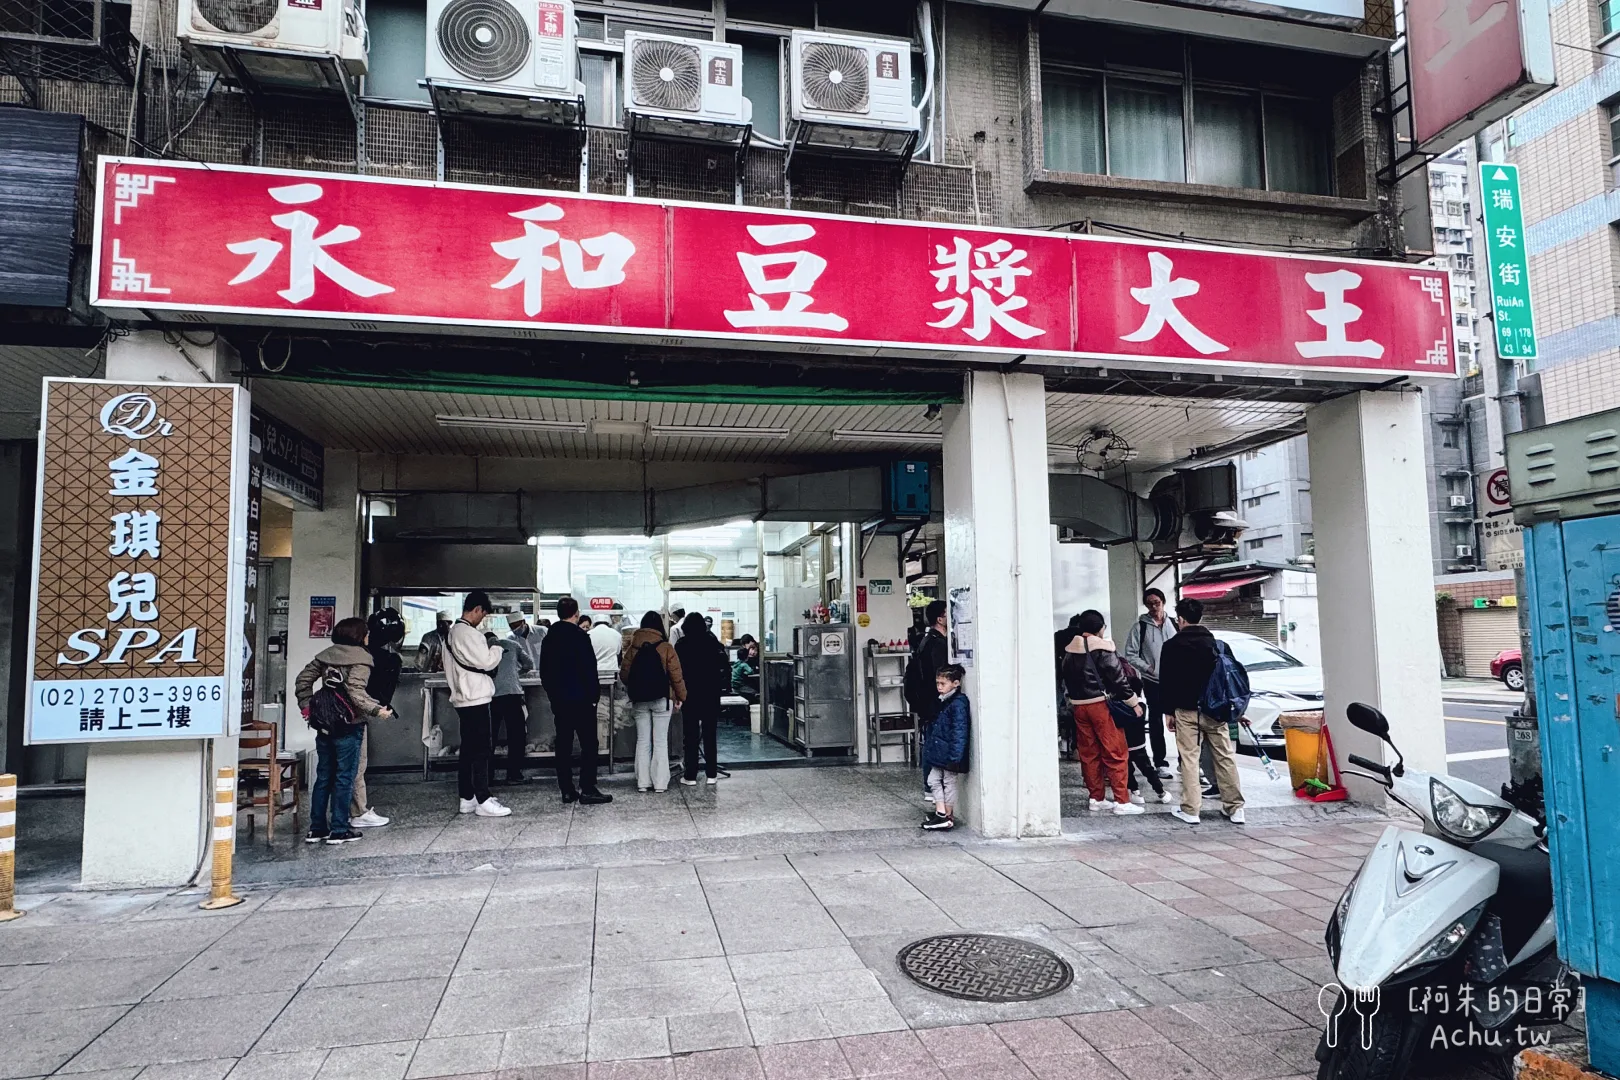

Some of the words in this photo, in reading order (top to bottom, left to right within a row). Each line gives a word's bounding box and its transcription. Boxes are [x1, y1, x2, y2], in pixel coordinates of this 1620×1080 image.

[544, 12, 557, 33] 禾聯
[714, 59, 727, 85] 萬士益
[882, 54, 895, 78] 萬士益
[1492, 188, 1520, 286] 瑞安街
[227, 184, 1385, 361] 永和豆漿大王
[1498, 310, 1511, 321] St.
[1502, 327, 1511, 337] 69
[1519, 327, 1532, 337] 178
[1504, 344, 1513, 354] 43
[1522, 344, 1532, 354] 94
[278, 434, 298, 466] SPA
[108, 448, 161, 622] 金琪兒
[877, 585, 890, 593] 102
[57, 627, 199, 666] SPA
[40, 684, 221, 706] (02)2703-3966
[79, 705, 192, 732] 請上二樓
